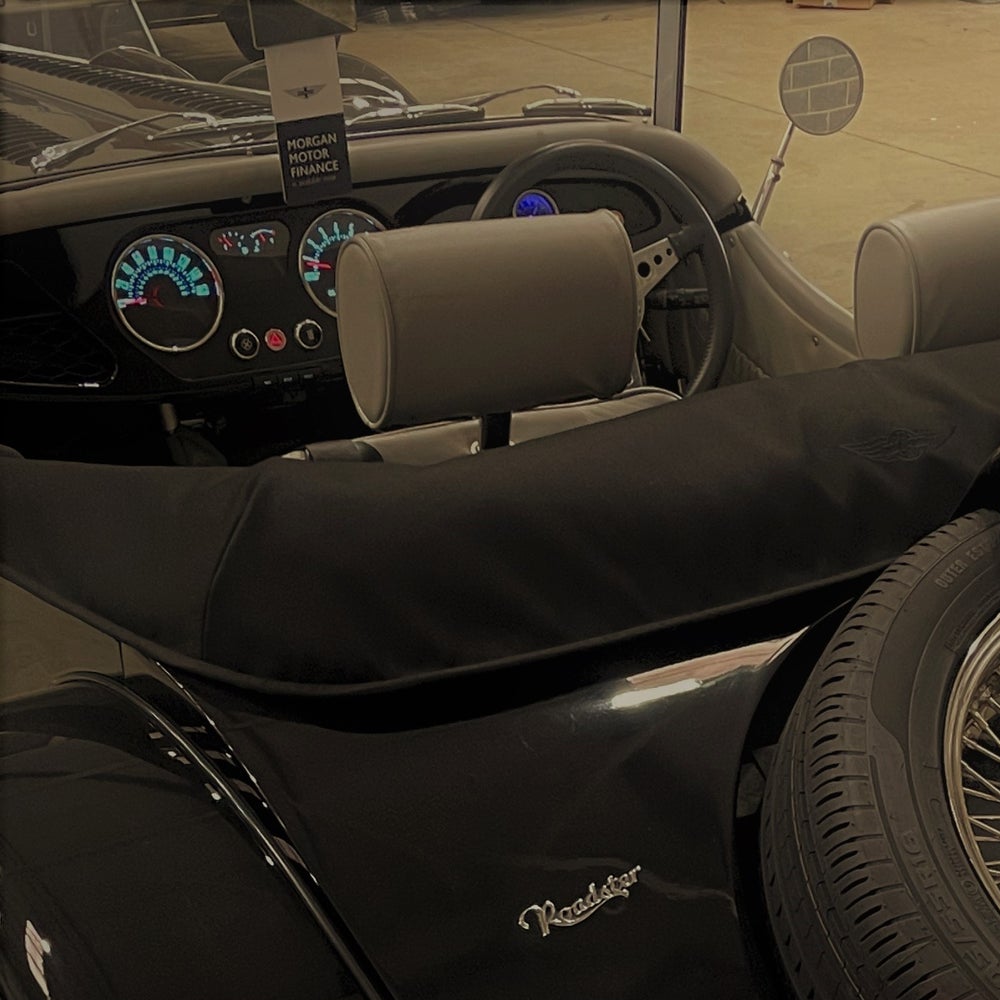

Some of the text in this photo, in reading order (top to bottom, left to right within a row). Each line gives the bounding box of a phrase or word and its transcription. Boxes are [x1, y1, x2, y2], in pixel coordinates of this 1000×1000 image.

[286, 132, 337, 151] MORGAN
[288, 147, 330, 165] MOTOR
[290, 159, 340, 179] FINANCE
[517, 864, 642, 937] Roadster
